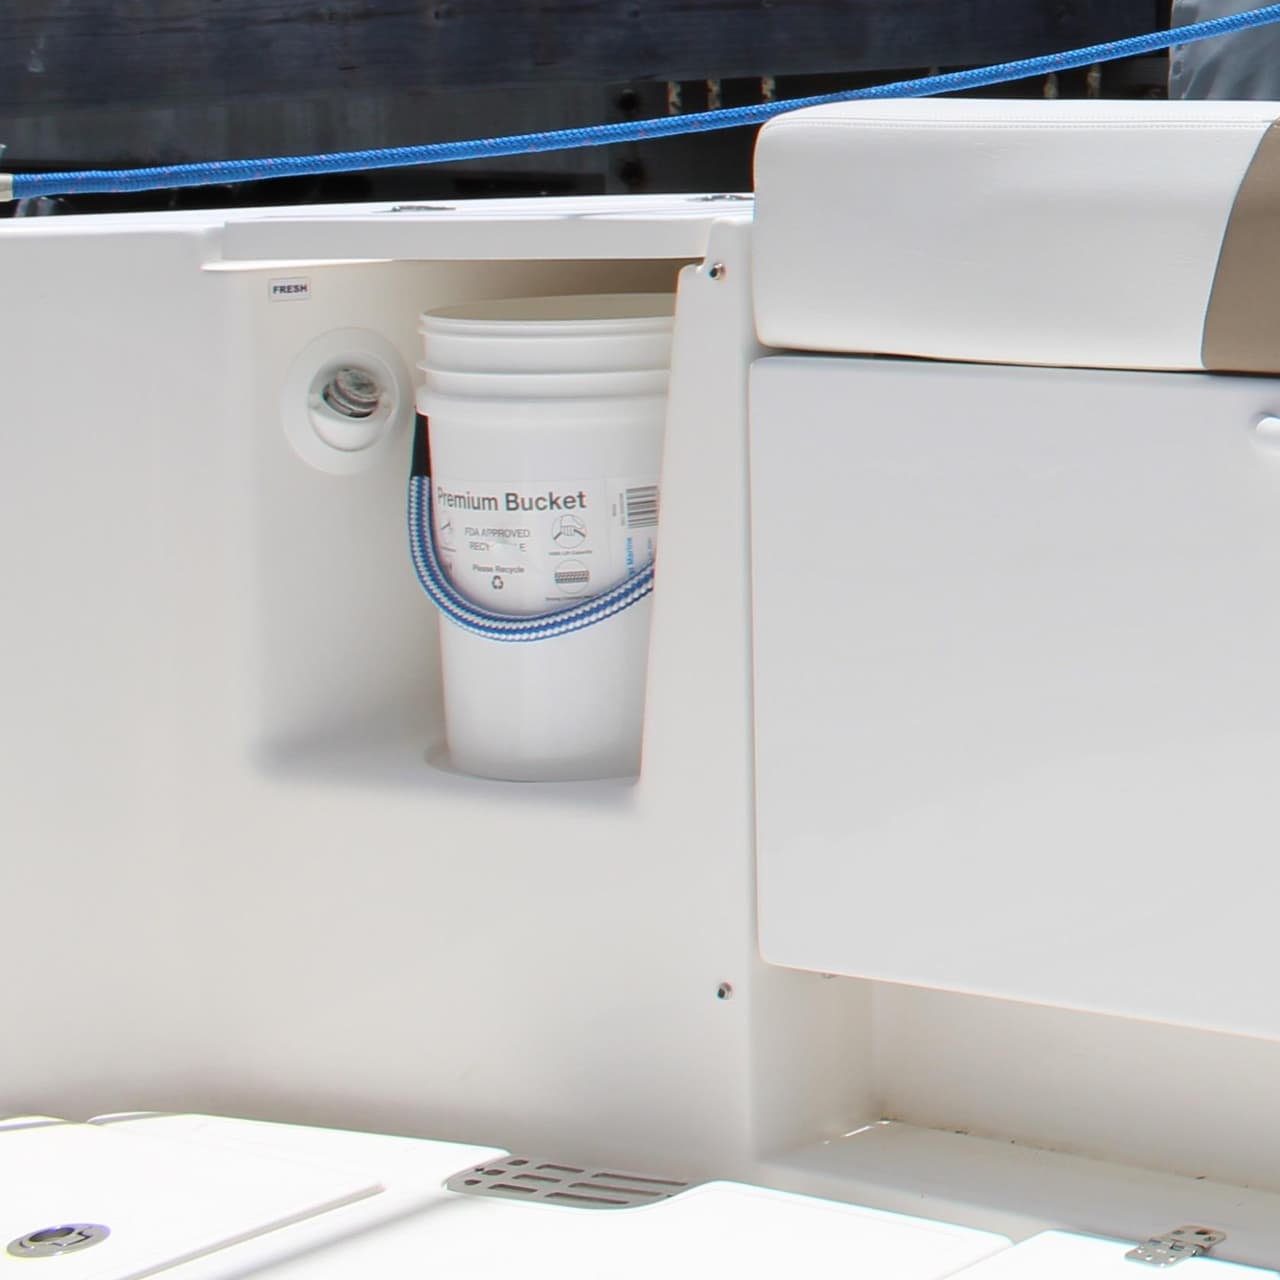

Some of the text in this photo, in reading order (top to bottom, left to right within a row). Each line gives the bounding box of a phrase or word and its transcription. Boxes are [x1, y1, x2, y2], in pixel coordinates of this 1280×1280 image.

[272, 284, 308, 294] FRESH
[437, 486, 498, 511] Premium
[505, 492, 587, 512] Bucket
[465, 527, 531, 538] FDA APPROVED
[495, 565, 525, 575] Recycle
